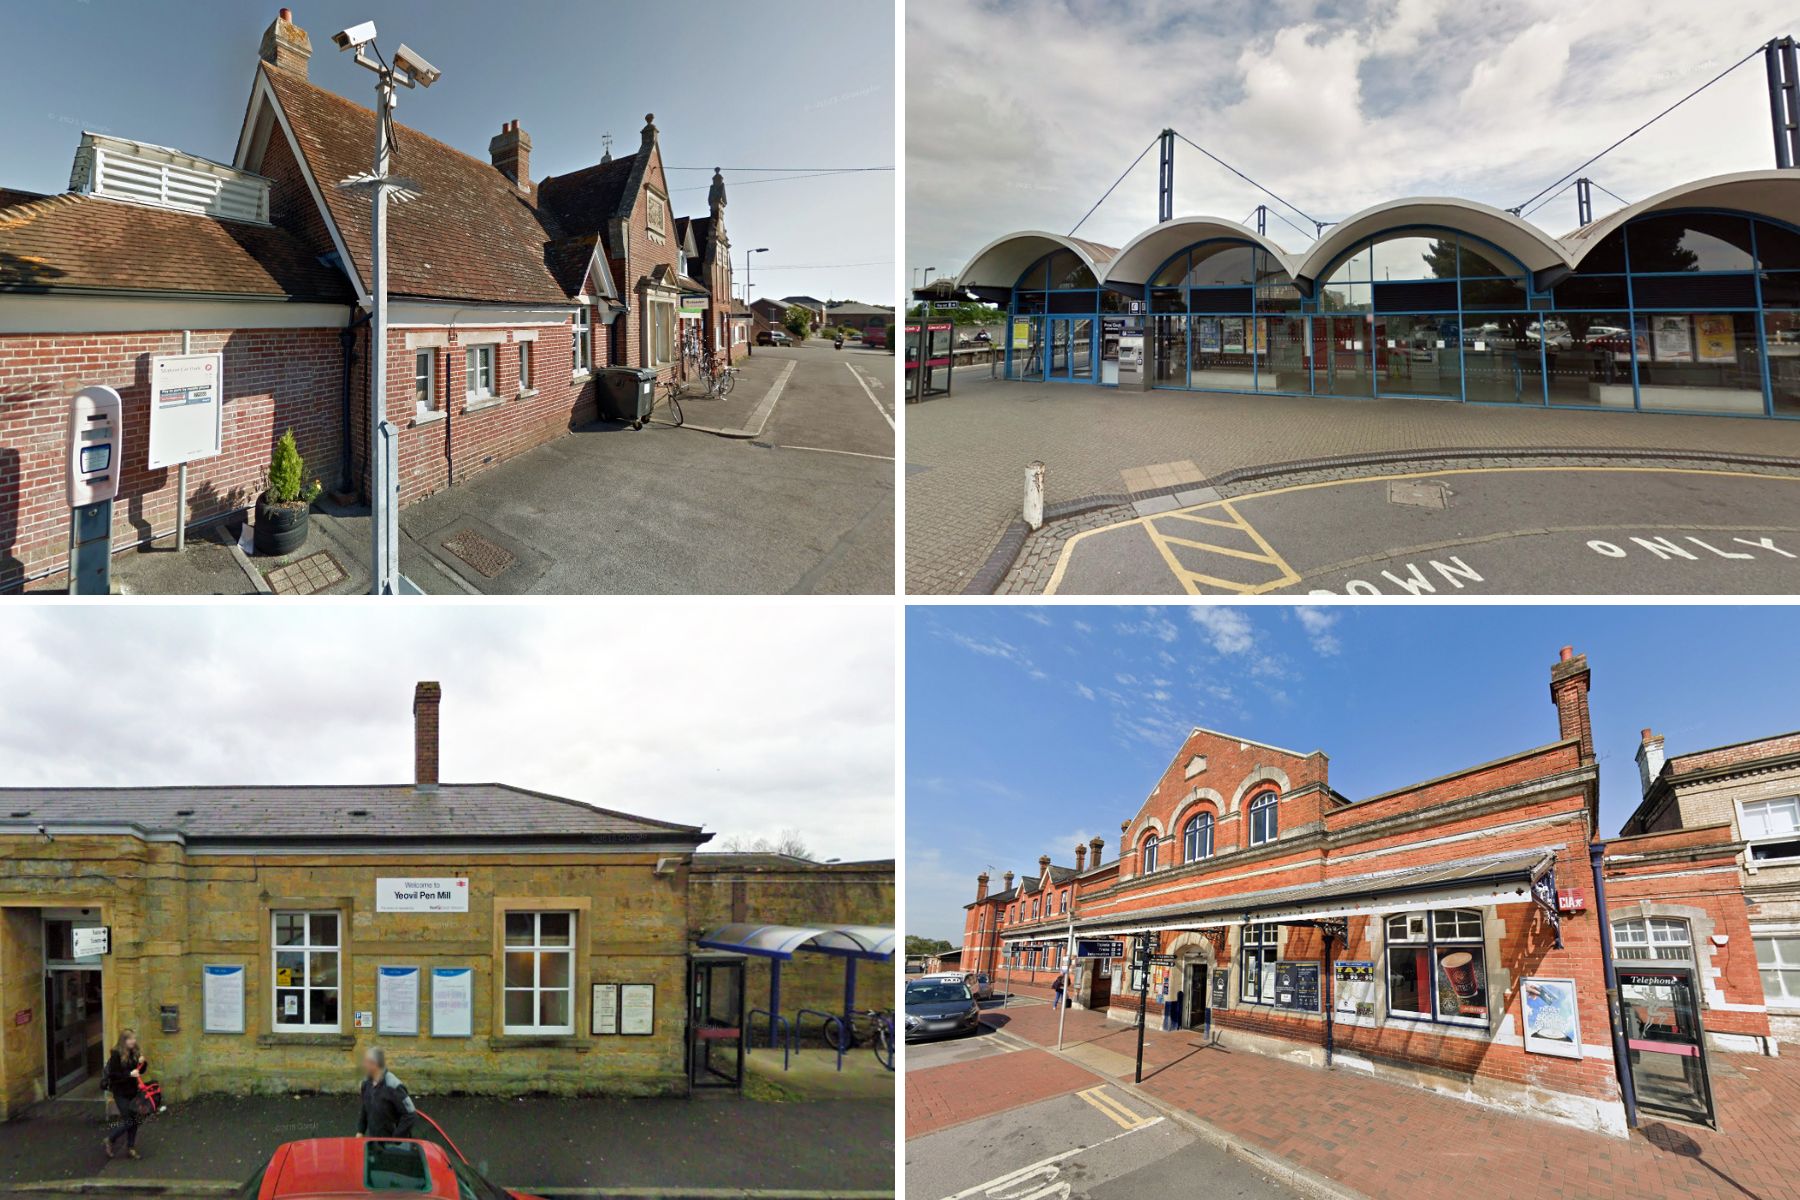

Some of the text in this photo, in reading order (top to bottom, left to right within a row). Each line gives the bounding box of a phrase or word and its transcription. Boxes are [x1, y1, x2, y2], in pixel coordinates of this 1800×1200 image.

[1308, 536, 1799, 595] OWN ONLY
[404, 881, 432, 889] Welcome
[394, 891, 451, 900] Yeovil Pen Mill
[1559, 896, 1575, 909] CIA
[1336, 966, 1374, 974] TAXI
[1630, 975, 1677, 986] Telephone
